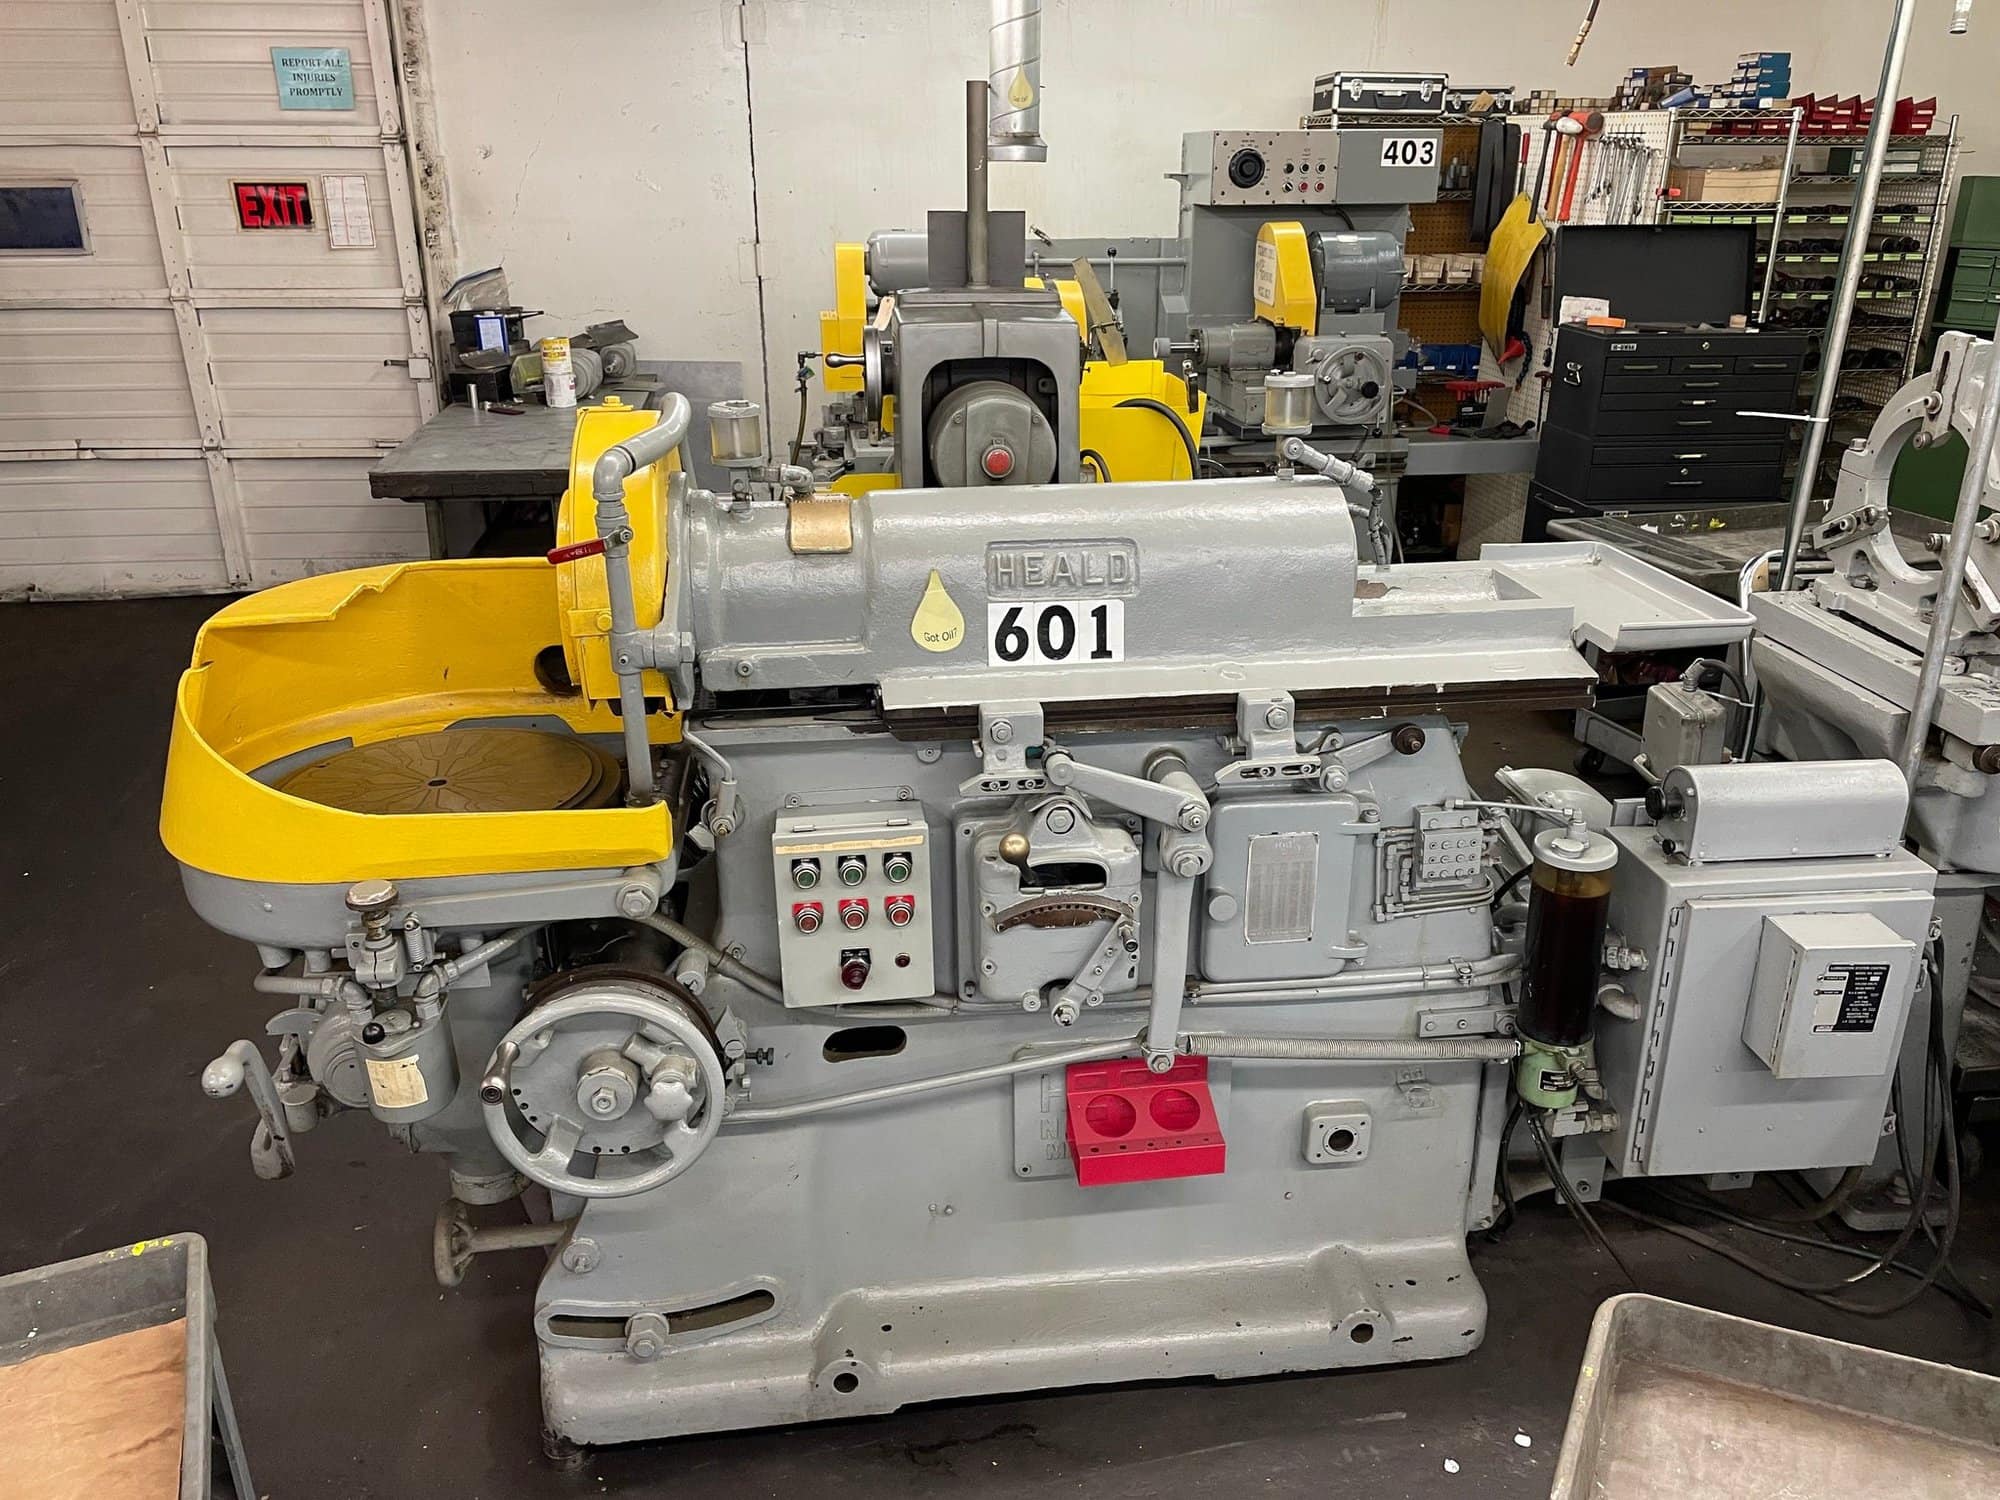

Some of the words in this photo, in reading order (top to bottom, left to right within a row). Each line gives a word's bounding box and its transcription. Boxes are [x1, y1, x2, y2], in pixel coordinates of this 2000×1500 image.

[281, 57, 321, 68] REPORT
[324, 57, 343, 68] ALL
[292, 73, 336, 83] INJURIES
[289, 87, 343, 97] PROMPTLY
[1383, 140, 1434, 165] 403
[237, 184, 306, 227] EXIT
[995, 550, 1129, 587] HEALD
[923, 631, 940, 643] Got
[994, 604, 1113, 662] 601
